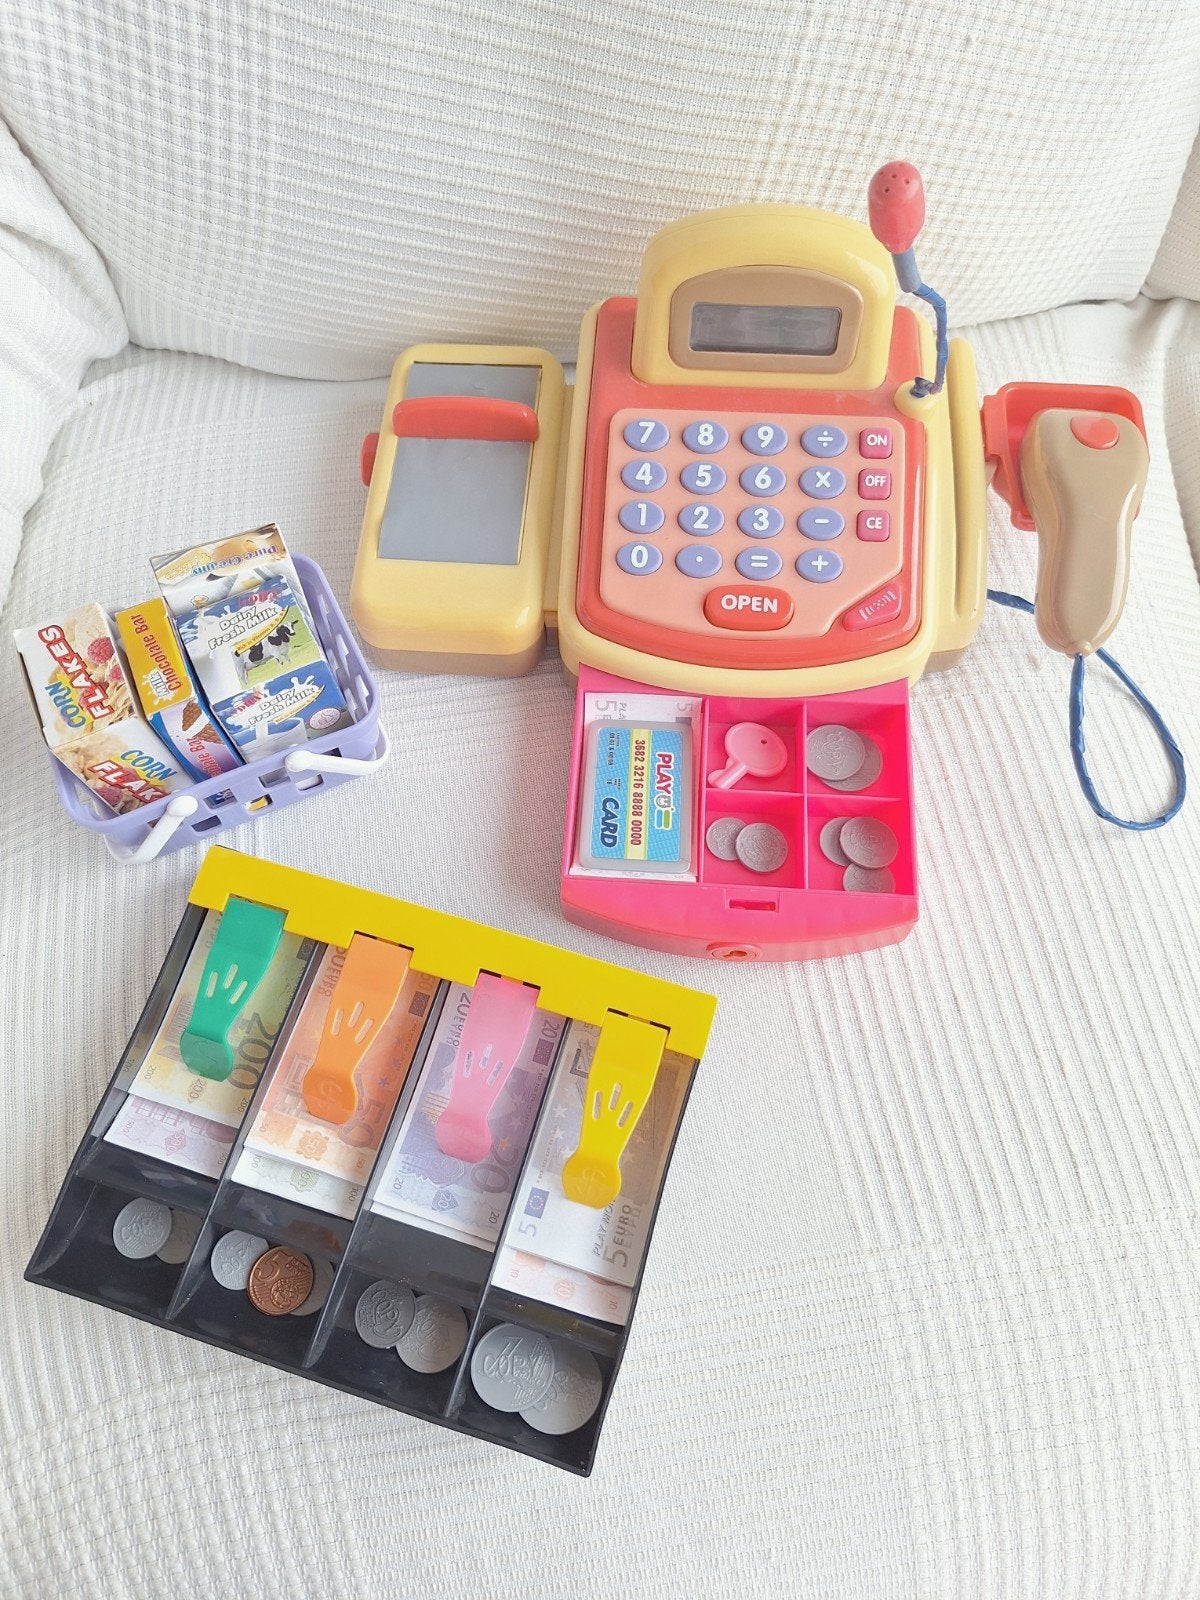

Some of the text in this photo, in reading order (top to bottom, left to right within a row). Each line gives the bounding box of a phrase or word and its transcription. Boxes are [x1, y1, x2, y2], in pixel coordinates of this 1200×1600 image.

[639, 422, 655, 444] 7
[699, 424, 714, 446] 8
[758, 426, 774, 448] 9
[866, 435, 887, 446] ON
[636, 463, 652, 484] 4
[696, 465, 712, 488] 5
[755, 467, 772, 488] 6
[866, 476, 886, 486] OFF
[638, 504, 646, 526] 1
[694, 506, 710, 529] 2
[753, 508, 769, 530] 3
[866, 518, 882, 529] CE
[245, 544, 278, 559] Pure
[631, 545, 648, 568] 0
[190, 556, 244, 575] Creamy
[720, 594, 778, 614] OPEN
[208, 625, 245, 650] Fresh
[247, 607, 278, 629] Milk
[219, 606, 258, 631] Dairy
[131, 613, 182, 692] Chocolate Bar
[38, 624, 114, 719] FLAKES
[45, 681, 86, 728] CORN
[260, 689, 297, 711] Dairy
[120, 750, 178, 781] CORN
[656, 754, 672, 794] PLAY
[87, 760, 171, 803] FLAK
[631, 740, 646, 846] 3682 3216 8888 0000
[601, 798, 619, 848] CARD
[541, 1019, 560, 1038] 20
[228, 1012, 282, 1091] 200
[144, 1064, 157, 1080] 200
[238, 1098, 248, 1114] 200
[393, 1177, 404, 1190] 20
[437, 1192, 451, 1208] 20
[488, 1211, 500, 1224] 20
[518, 1224, 537, 1238] 5
[603, 1204, 632, 1268] 5 EURO
[254, 1250, 288, 1284] 5
[556, 1286, 570, 1300] 10
